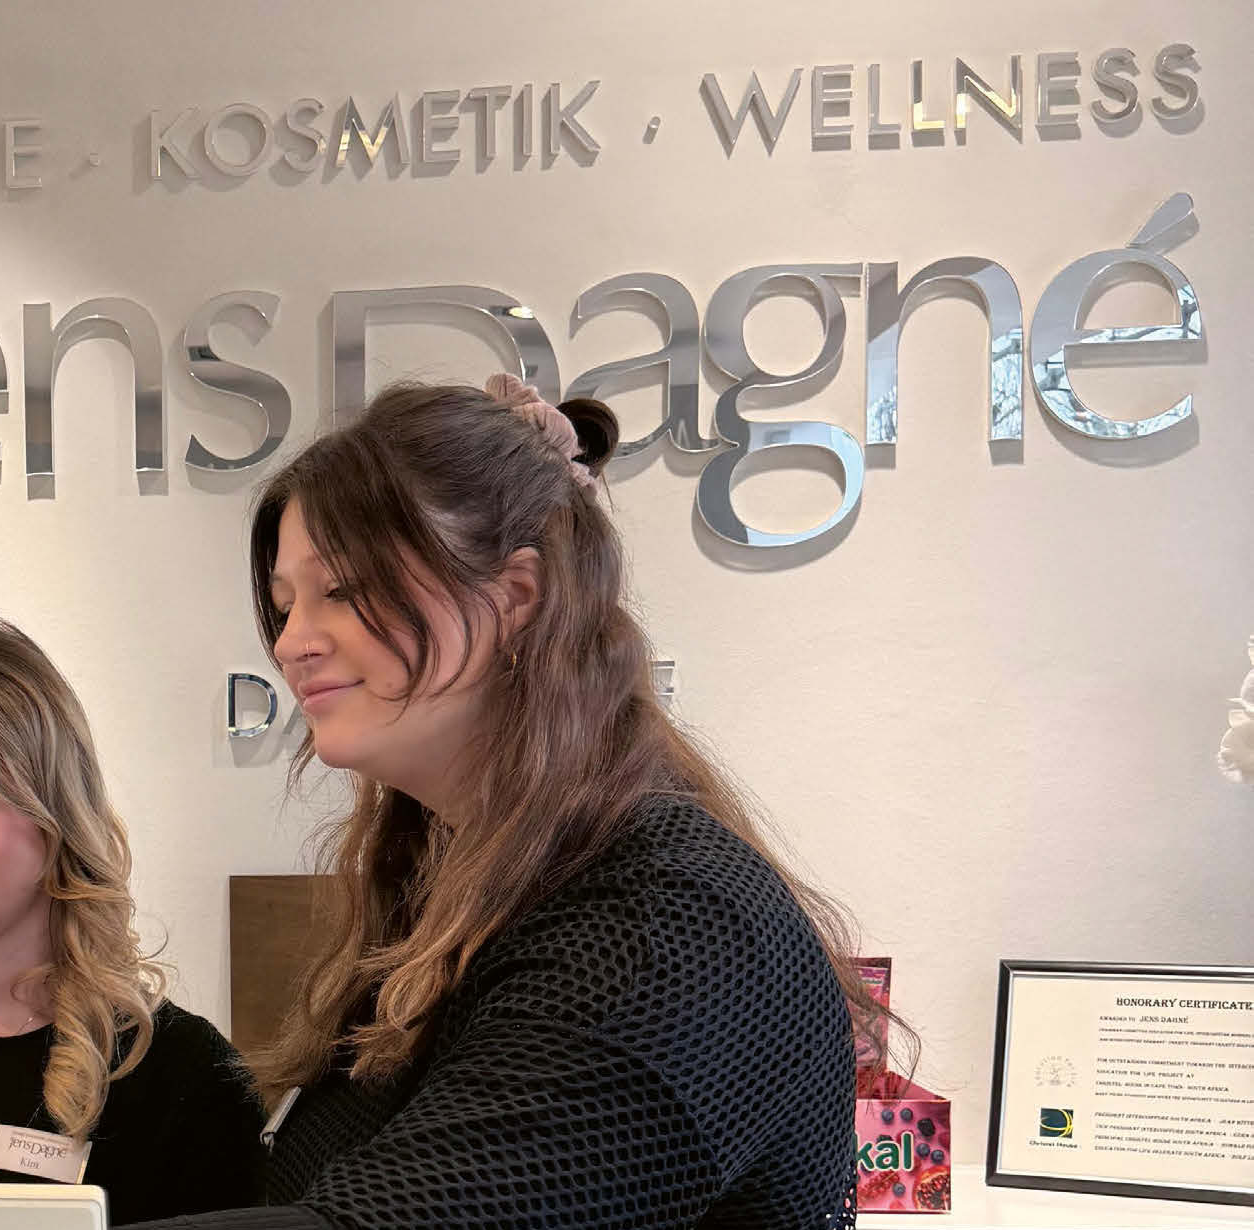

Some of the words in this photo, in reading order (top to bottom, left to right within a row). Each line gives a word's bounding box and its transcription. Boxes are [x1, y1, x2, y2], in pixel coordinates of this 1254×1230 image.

[150, 80, 602, 181] KOSMETIK
[700, 43, 1202, 156] WELLNESS
[1116, 997, 1178, 1008] HONORARY
[1179, 999, 1254, 1011] CERTIFICATE
[1139, 1015, 1160, 1023] JENS
